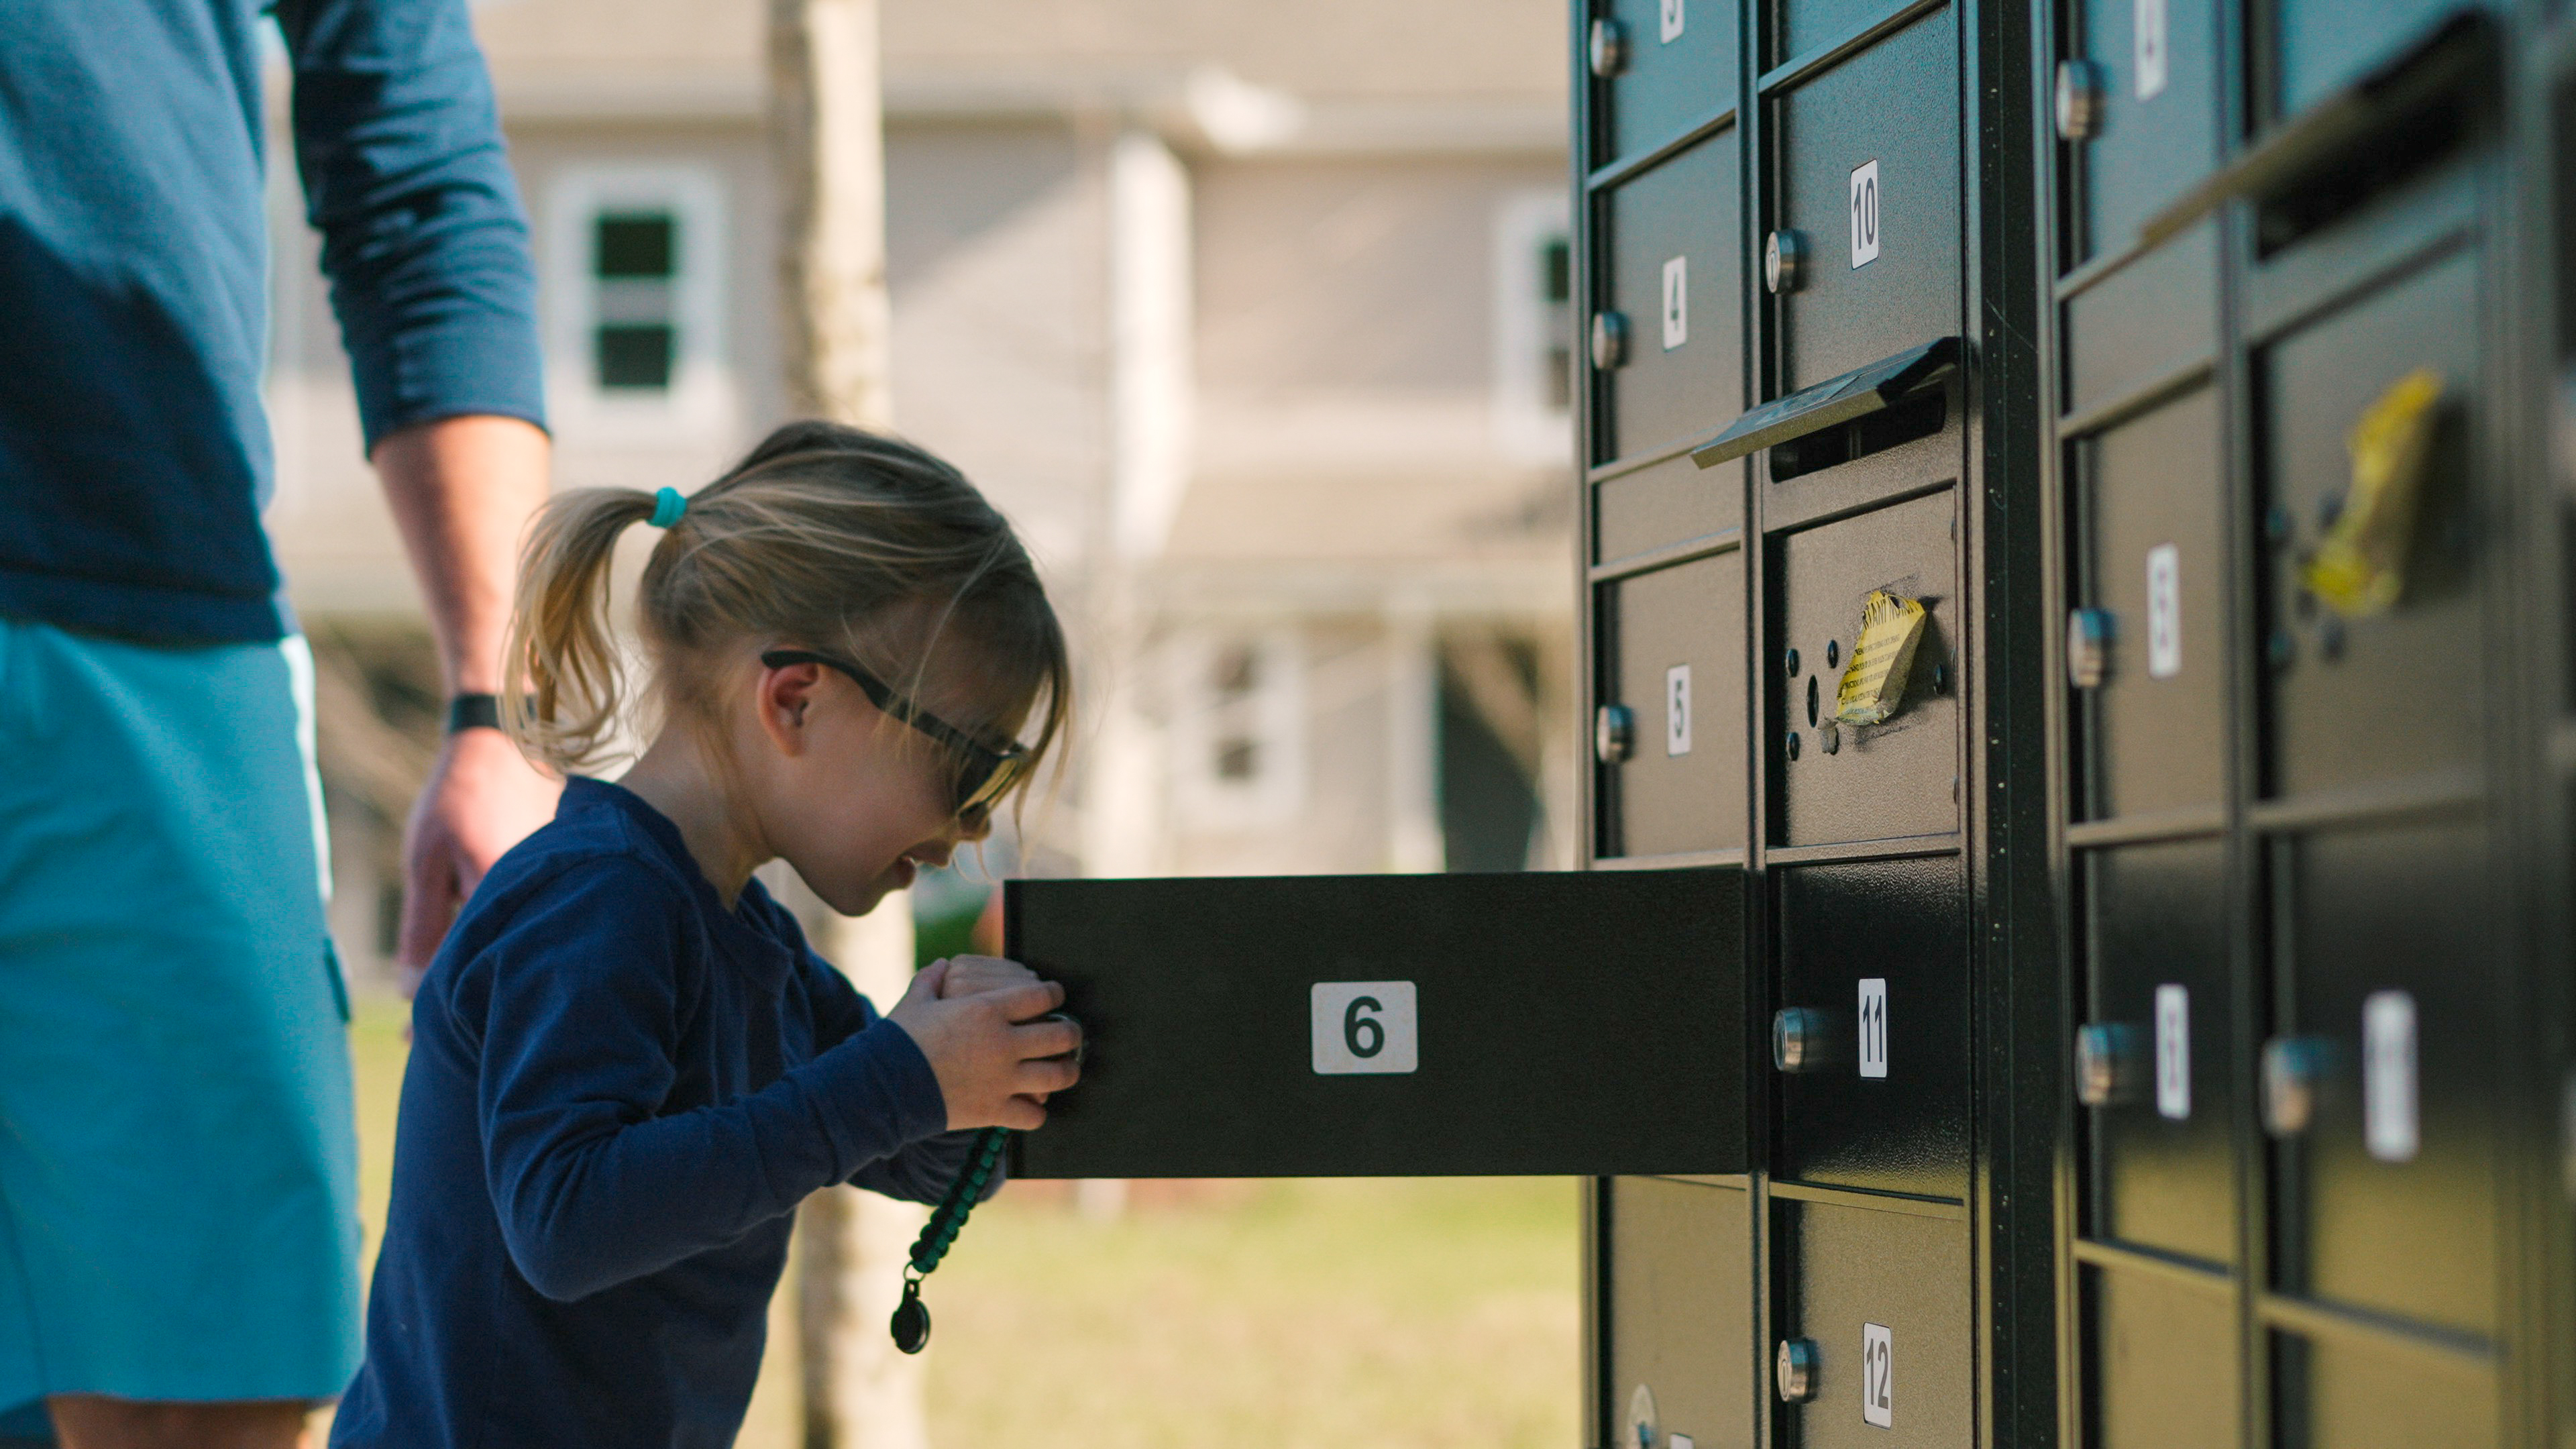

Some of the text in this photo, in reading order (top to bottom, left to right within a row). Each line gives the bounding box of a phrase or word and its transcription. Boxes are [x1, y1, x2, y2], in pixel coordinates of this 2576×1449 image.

[1854, 177, 1875, 250] 10
[1669, 271, 1680, 331] 4
[1674, 679, 1685, 739] 5
[1344, 996, 1385, 1059] 6
[1863, 995, 1882, 1062] 11
[1866, 1338, 1888, 1409] 12
